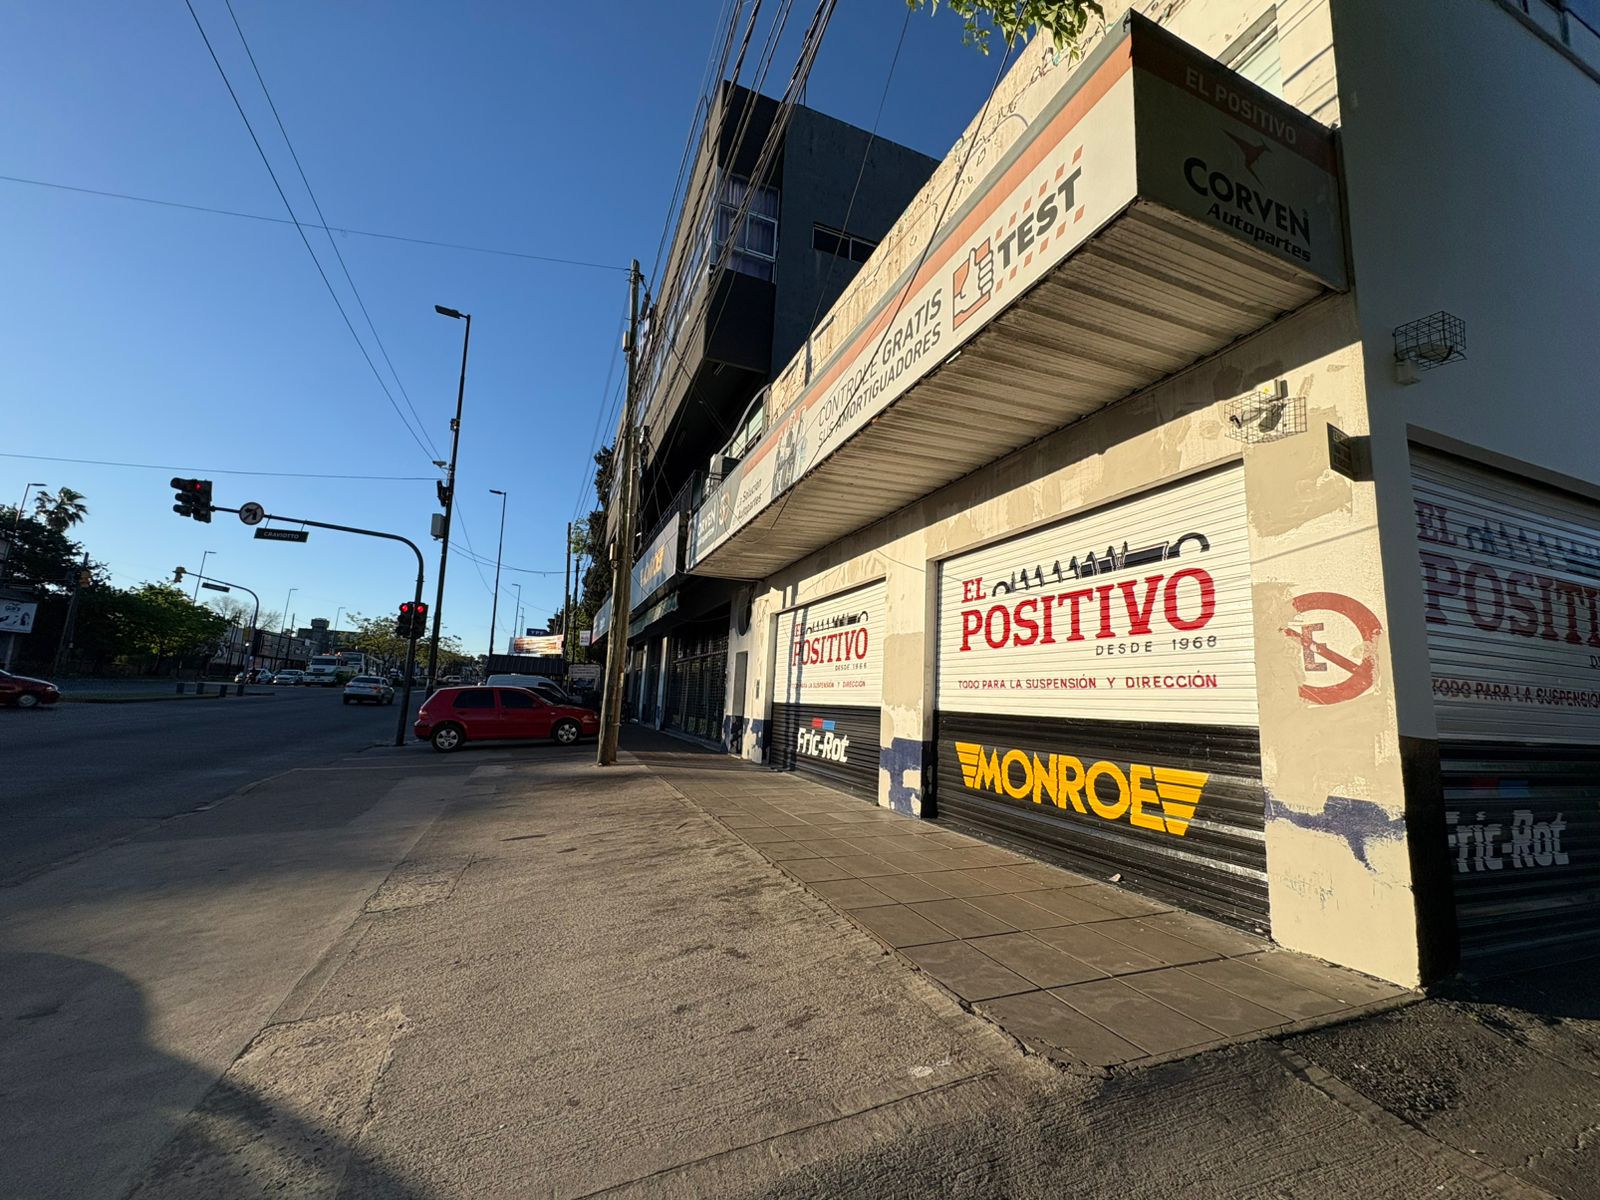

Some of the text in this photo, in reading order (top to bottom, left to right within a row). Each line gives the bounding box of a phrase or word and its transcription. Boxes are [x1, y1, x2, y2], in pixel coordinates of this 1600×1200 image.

[1186, 66, 1297, 145] EL POSITIVO
[997, 166, 1082, 270] TEST
[1183, 157, 1311, 247] CORVEN
[1206, 203, 1312, 263] Autopartes
[882, 288, 943, 366] GRATIS
[834, 321, 942, 432] AMORTIGUADORES
[1413, 500, 1458, 546] EL
[959, 567, 1217, 652] POSITIVO
[961, 577, 987, 603] EL
[792, 627, 869, 666] POSITIVO
[1095, 635, 1217, 656] DESDE 1968
[958, 670, 1218, 689] TODO PARA LA SUSPENSIÓN Y DIRECCIÓN
[1431, 679, 1472, 698] TODO
[1475, 683, 1510, 702] PARA
[1514, 686, 1533, 703] LA
[796, 727, 850, 763] Fric-Rot
[974, 745, 1168, 832] MONROE
